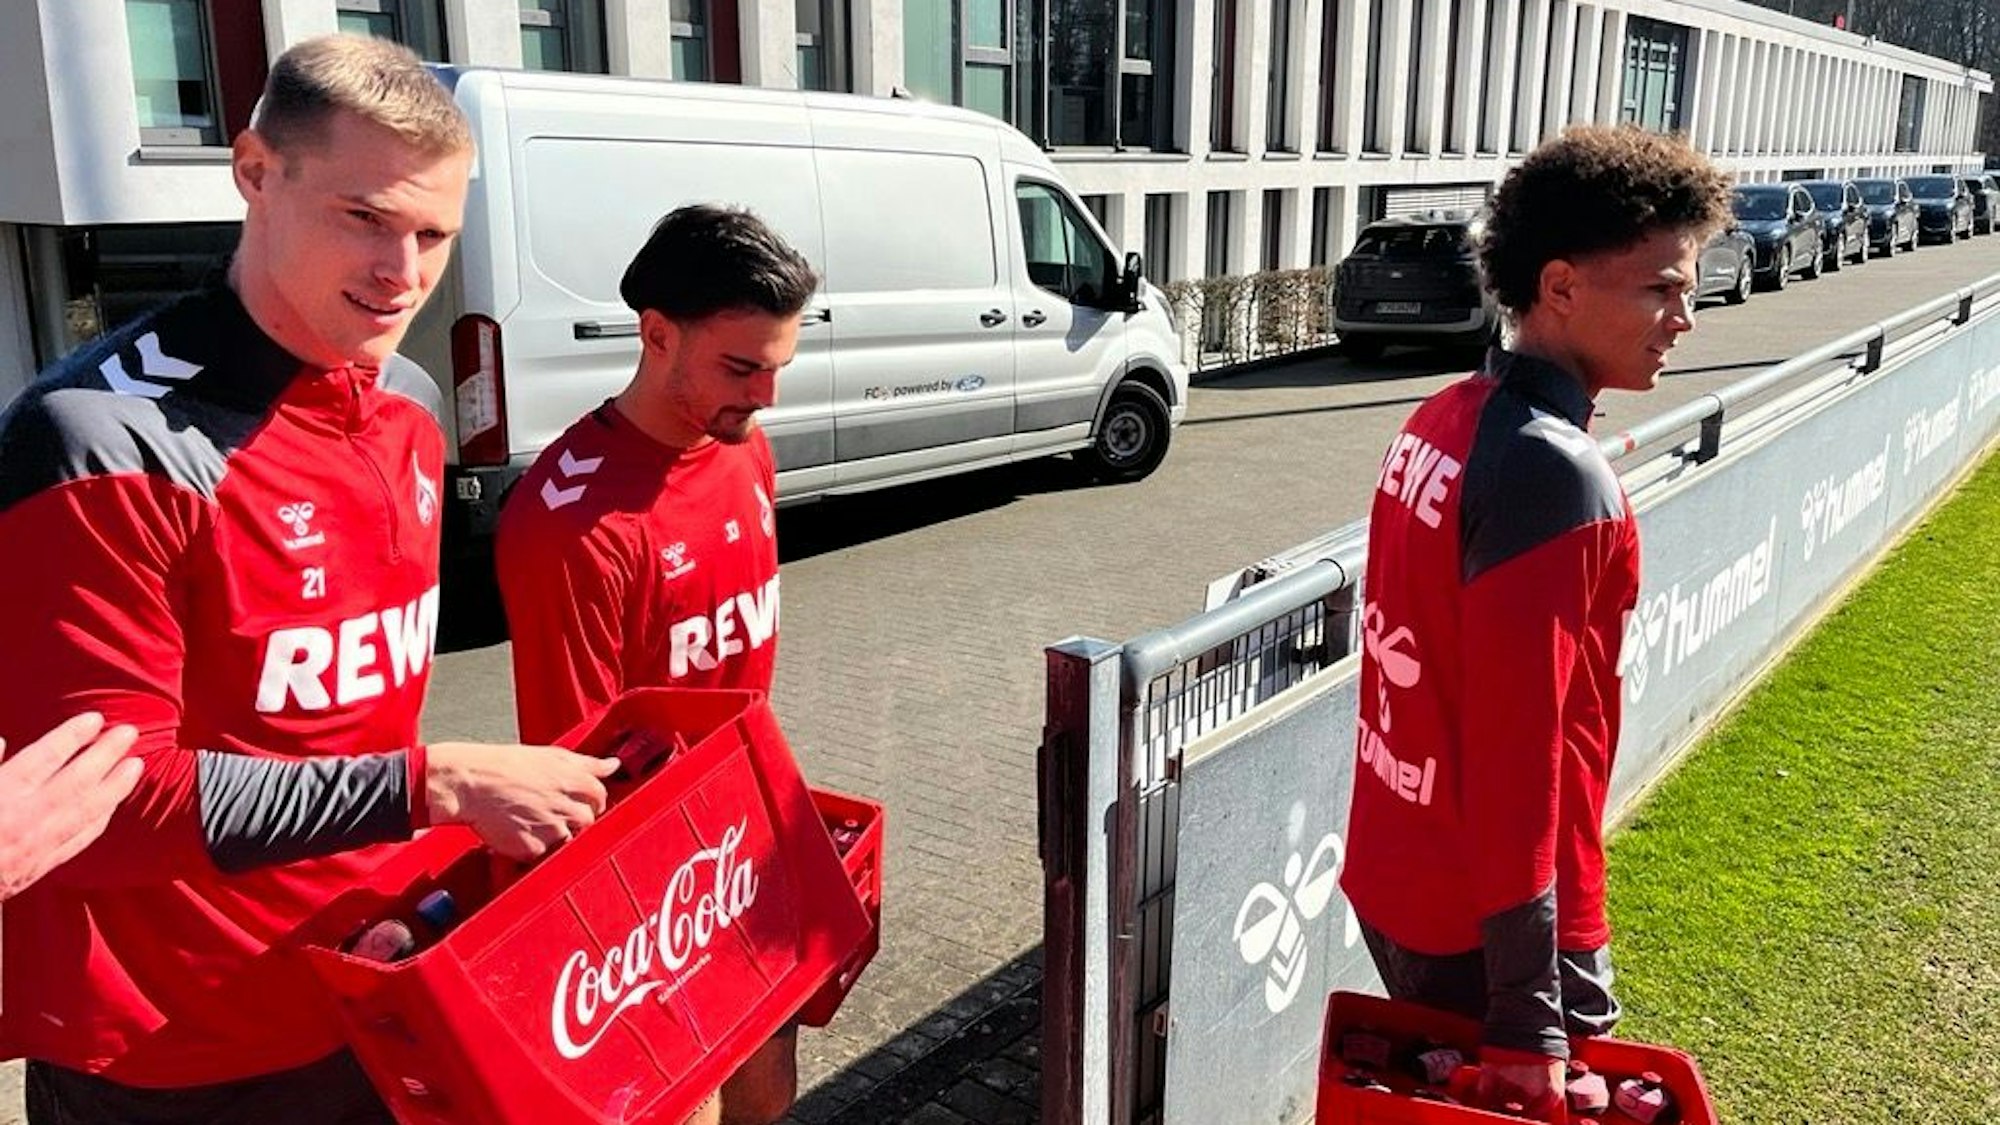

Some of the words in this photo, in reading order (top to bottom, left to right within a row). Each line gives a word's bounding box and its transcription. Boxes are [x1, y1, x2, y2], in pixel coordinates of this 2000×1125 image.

[865, 386, 879, 400] FC
[893, 381, 938, 397] powered
[941, 379, 953, 392] by
[1377, 432, 1462, 528] EWE
[1822, 433, 1891, 544] hummel
[302, 566, 326, 600] 21
[669, 573, 781, 679] REW
[1663, 514, 1776, 676] hummel
[255, 583, 441, 713] REW
[552, 815, 760, 1060] Coca-Cola
